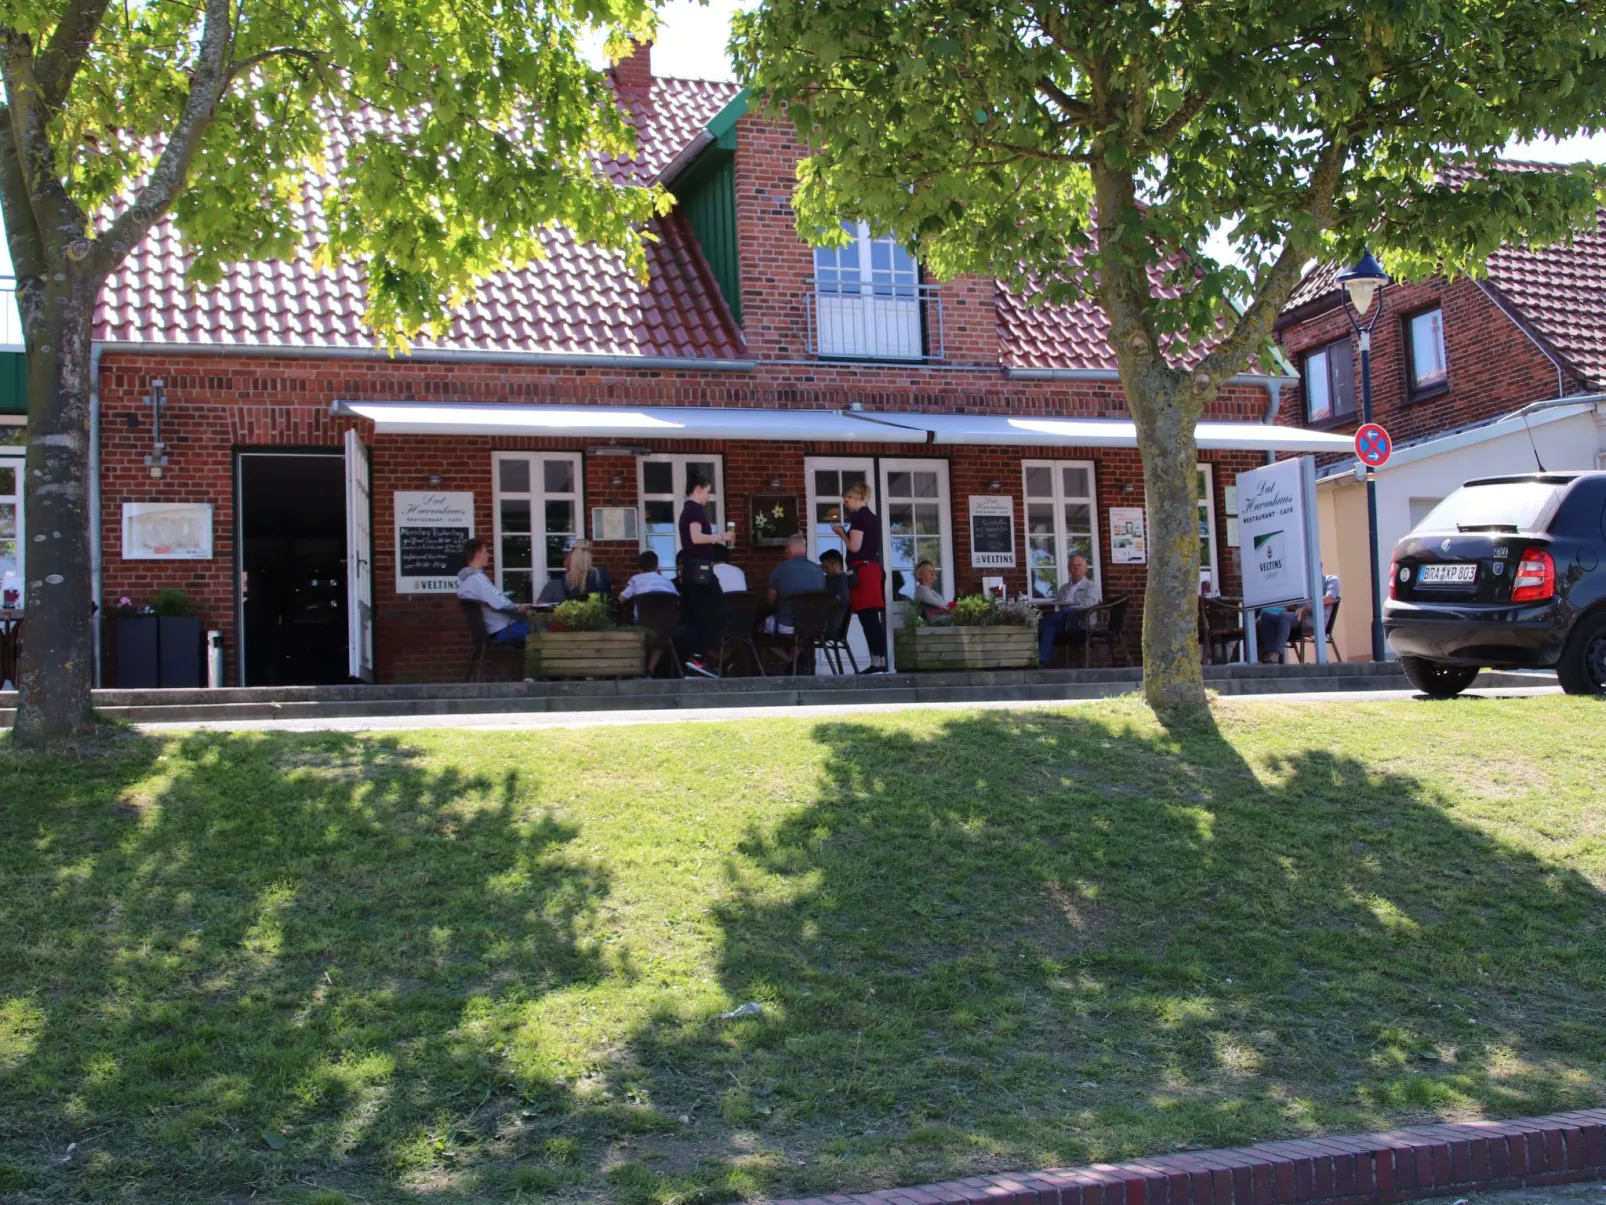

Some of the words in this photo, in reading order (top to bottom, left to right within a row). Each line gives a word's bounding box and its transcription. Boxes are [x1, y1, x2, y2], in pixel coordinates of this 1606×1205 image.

[1243, 511, 1275, 524] RESTAURANT
[982, 555, 1013, 564] VELTINS
[1259, 560, 1282, 572] VELTINS
[1424, 567, 1439, 580] BRA
[1445, 567, 1457, 580] XP
[1458, 566, 1475, 580] 803
[421, 580, 460, 590] VELTINS
